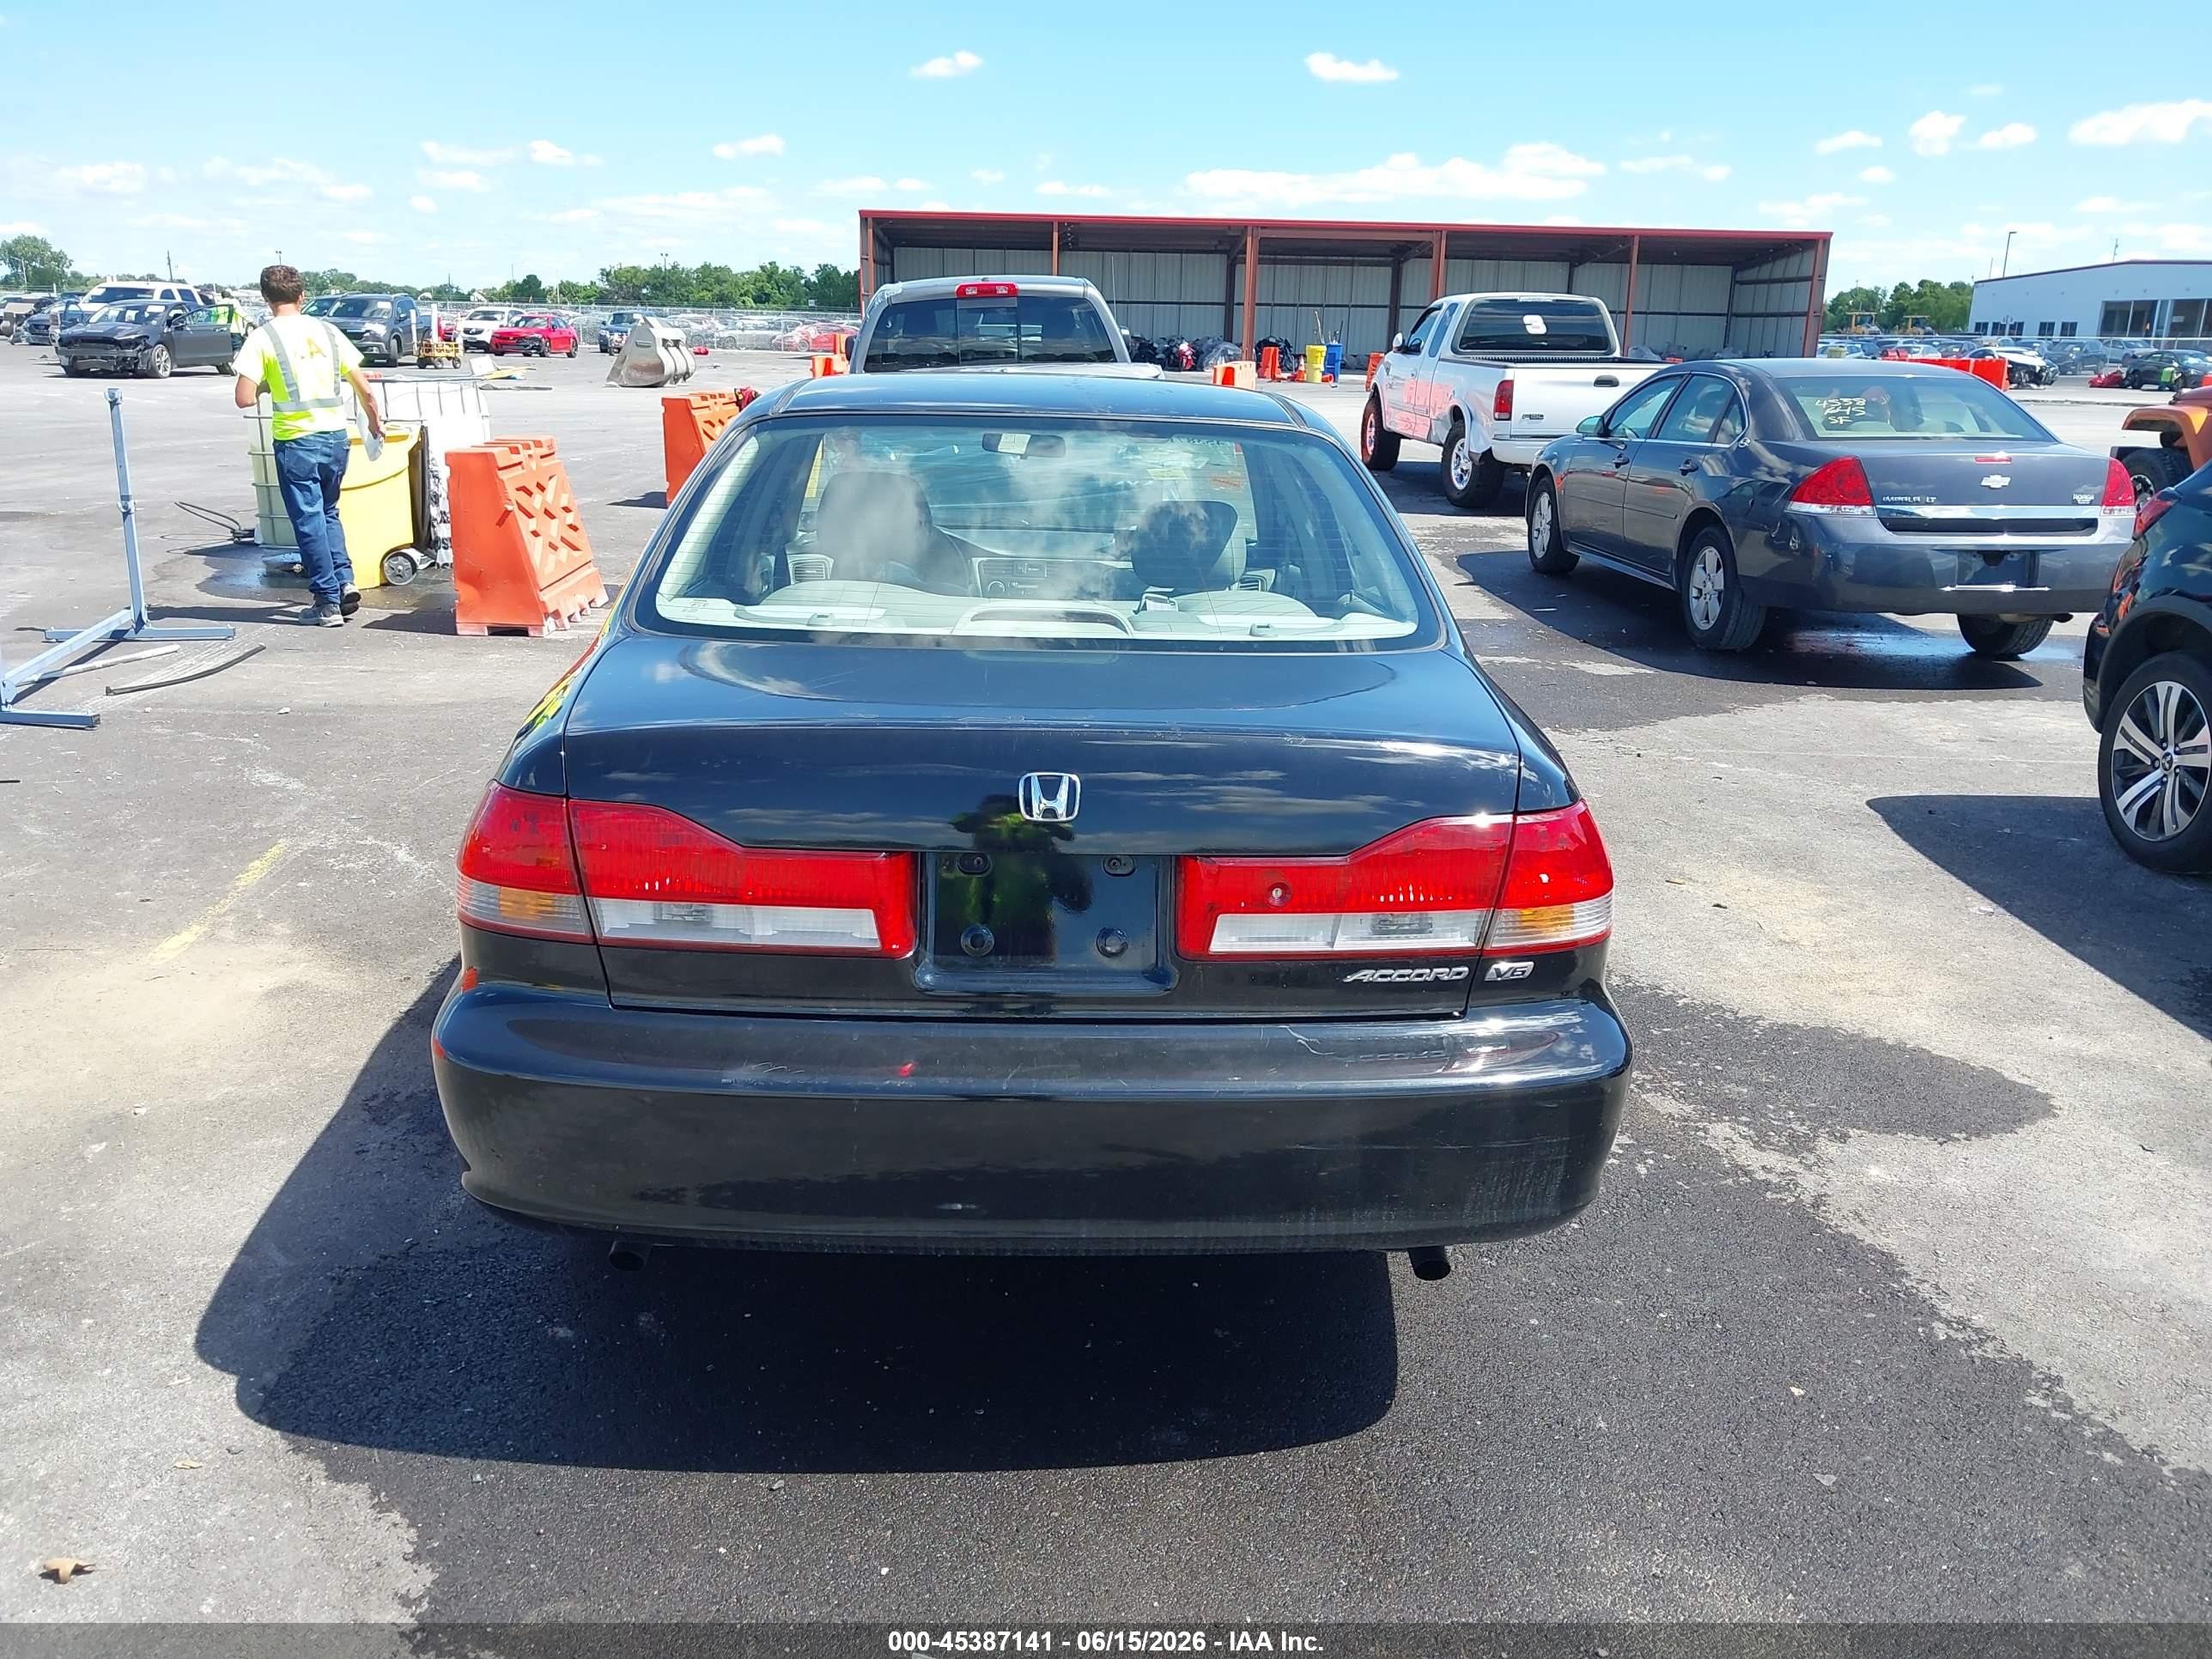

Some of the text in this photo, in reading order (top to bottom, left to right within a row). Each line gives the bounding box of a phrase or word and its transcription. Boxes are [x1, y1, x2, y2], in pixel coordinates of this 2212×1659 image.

[1523, 314, 1547, 334] 3
[1815, 398, 1866, 408] 4538
[1827, 416, 1853, 424] SF
[1342, 962, 1534, 982] ACCORD V6
